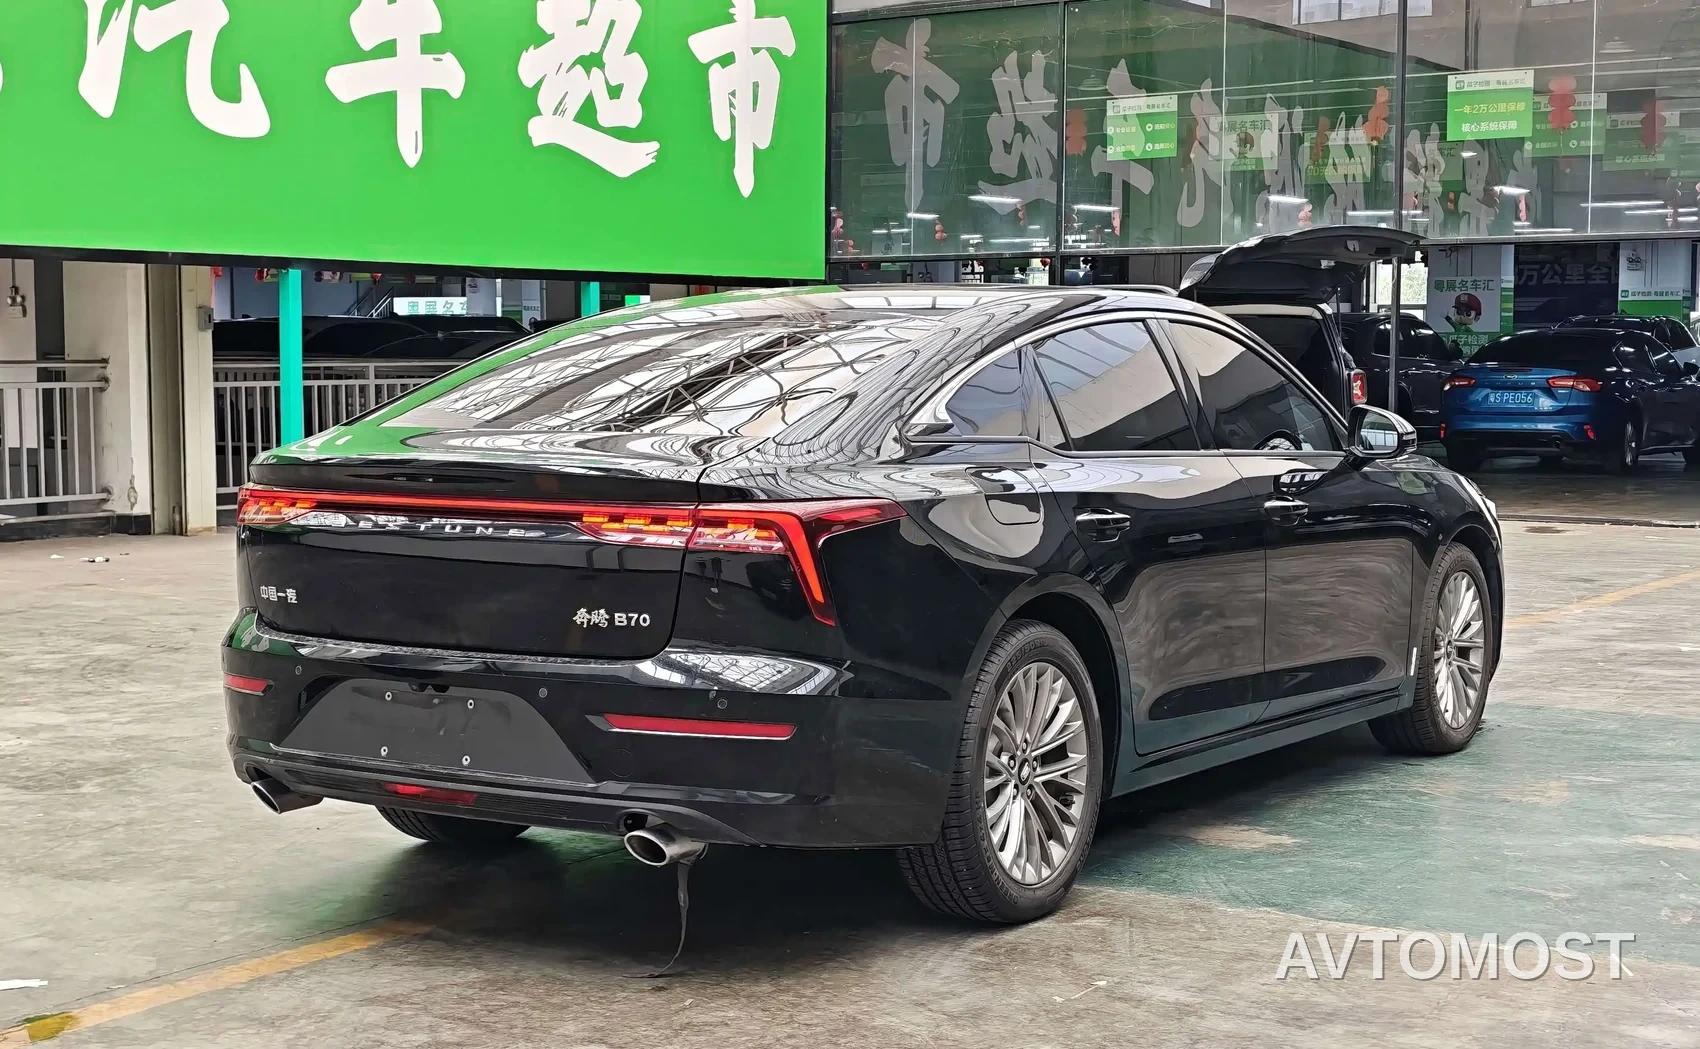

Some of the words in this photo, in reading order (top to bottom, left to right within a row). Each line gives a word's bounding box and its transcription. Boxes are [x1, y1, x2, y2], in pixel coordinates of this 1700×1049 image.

[1461, 120, 1518, 132] 核心系统保障
[260, 585, 298, 604] 中国一汽
[573, 607, 610, 628] 奔腾
[614, 612, 651, 627] B70
